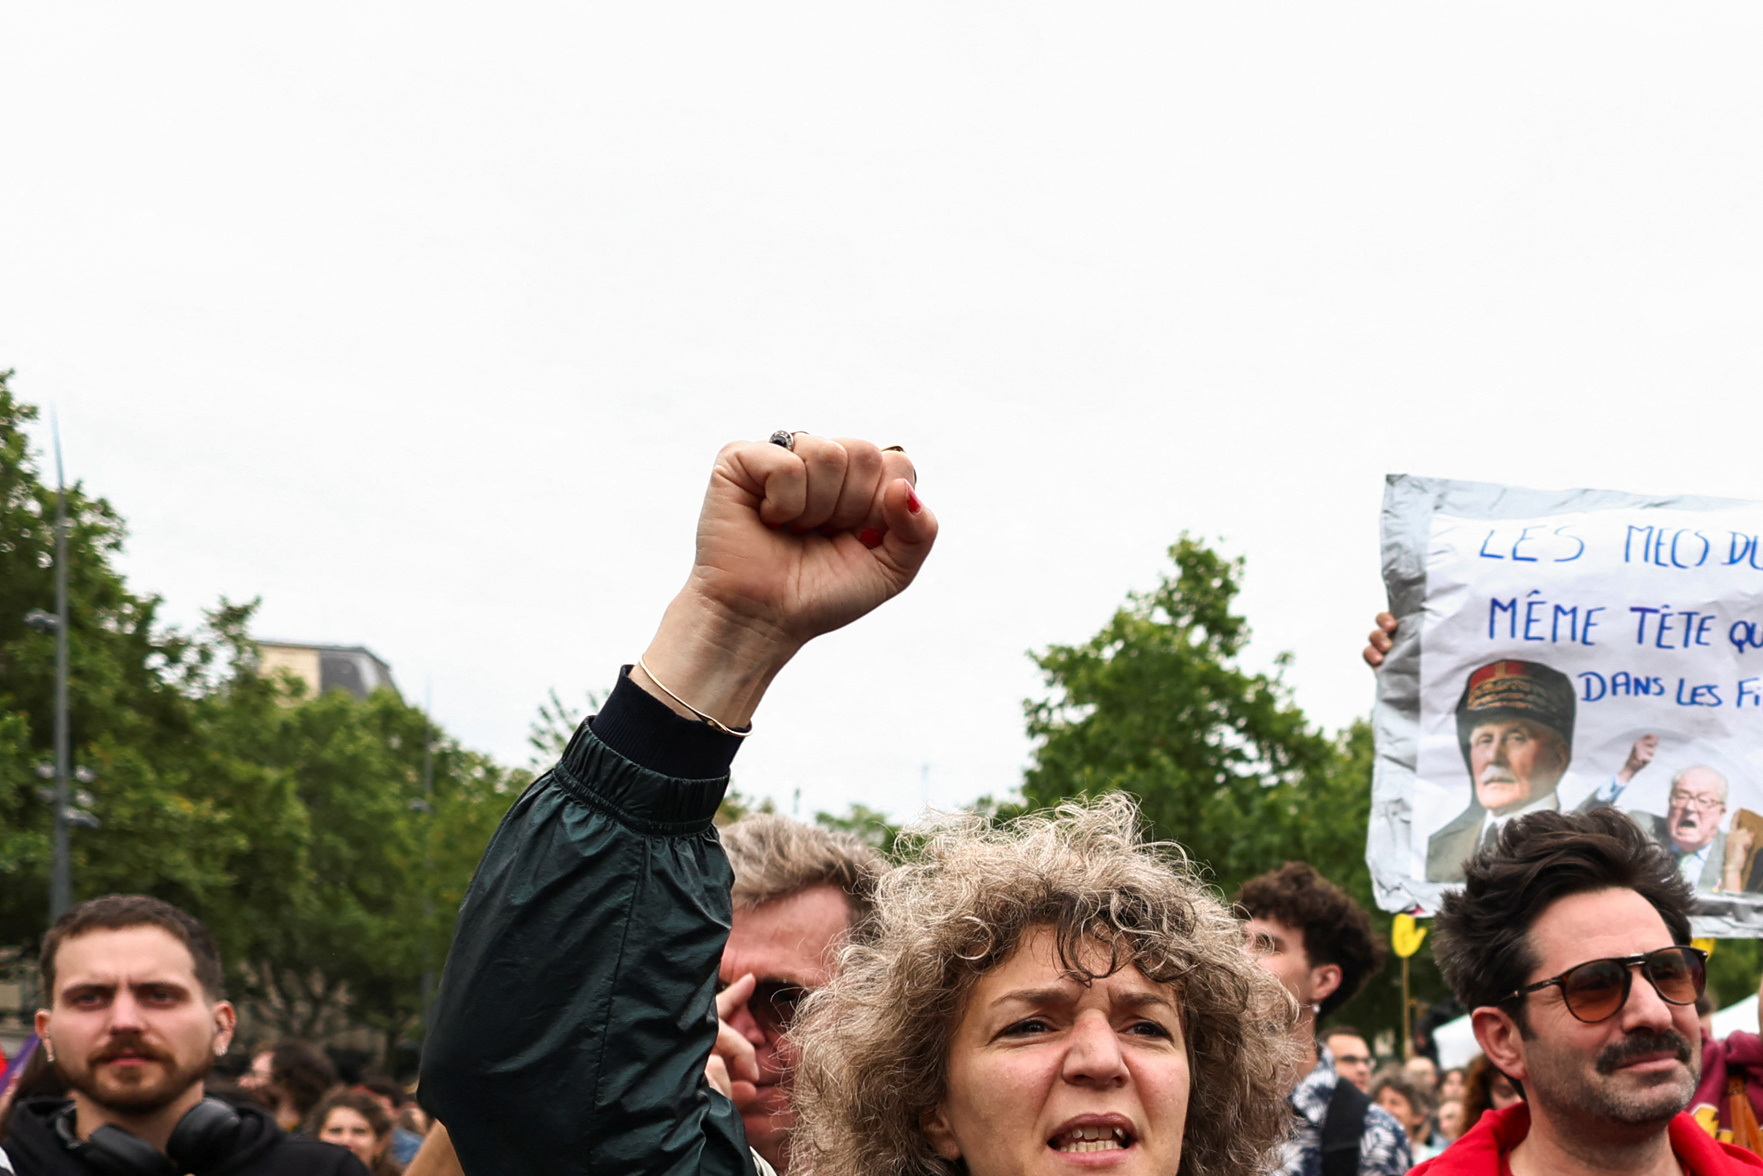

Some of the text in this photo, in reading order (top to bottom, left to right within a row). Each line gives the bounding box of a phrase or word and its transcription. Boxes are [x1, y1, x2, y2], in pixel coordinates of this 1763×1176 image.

[1479, 524, 1586, 563] LES
[1623, 524, 1711, 570] MECS
[1488, 590, 1607, 646] MÊME
[1629, 604, 1717, 650] TÊTE
[1577, 670, 1666, 703] DANS
[1675, 677, 1724, 708] LES
